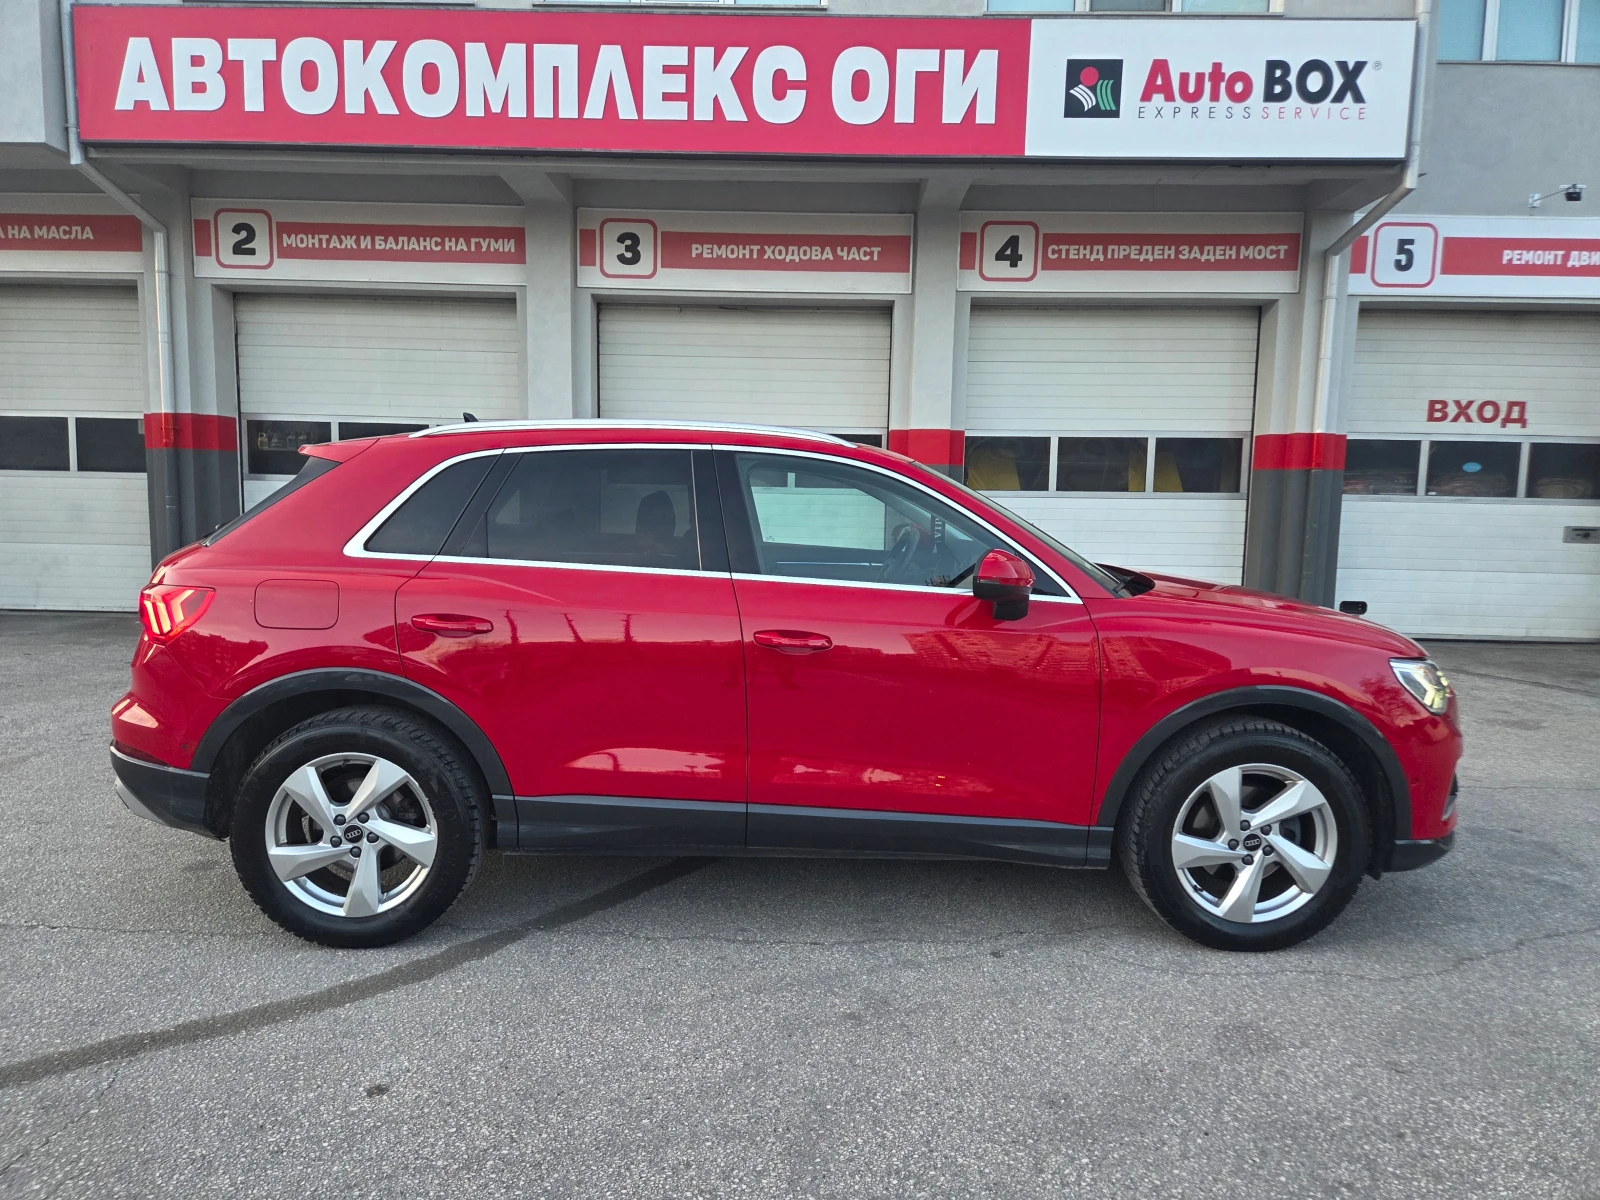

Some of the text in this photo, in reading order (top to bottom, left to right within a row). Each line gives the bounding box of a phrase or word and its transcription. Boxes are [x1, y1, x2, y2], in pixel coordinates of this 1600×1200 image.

[114, 36, 999, 126] АВТОКОМПЛЕКС ОГИ
[1139, 58, 1254, 104] Auto
[7, 225, 31, 239] НА
[33, 225, 95, 240] МАСЛА
[231, 222, 257, 256] 2
[282, 233, 516, 253] МОНТАЖ И БАЛАНС НА ГУМИ
[616, 231, 642, 266] 3
[691, 243, 882, 263] РЕМОНТ ХОДОВА ЧАСТ
[994, 234, 1023, 268] 4
[1047, 245, 1289, 262] СТЕНД ПРЕДЕН ЗАДЕН МОСТ
[1393, 238, 1416, 272] 5
[1502, 250, 1565, 265] РЕМОНТ
[1426, 399, 1528, 429] ВХОД
